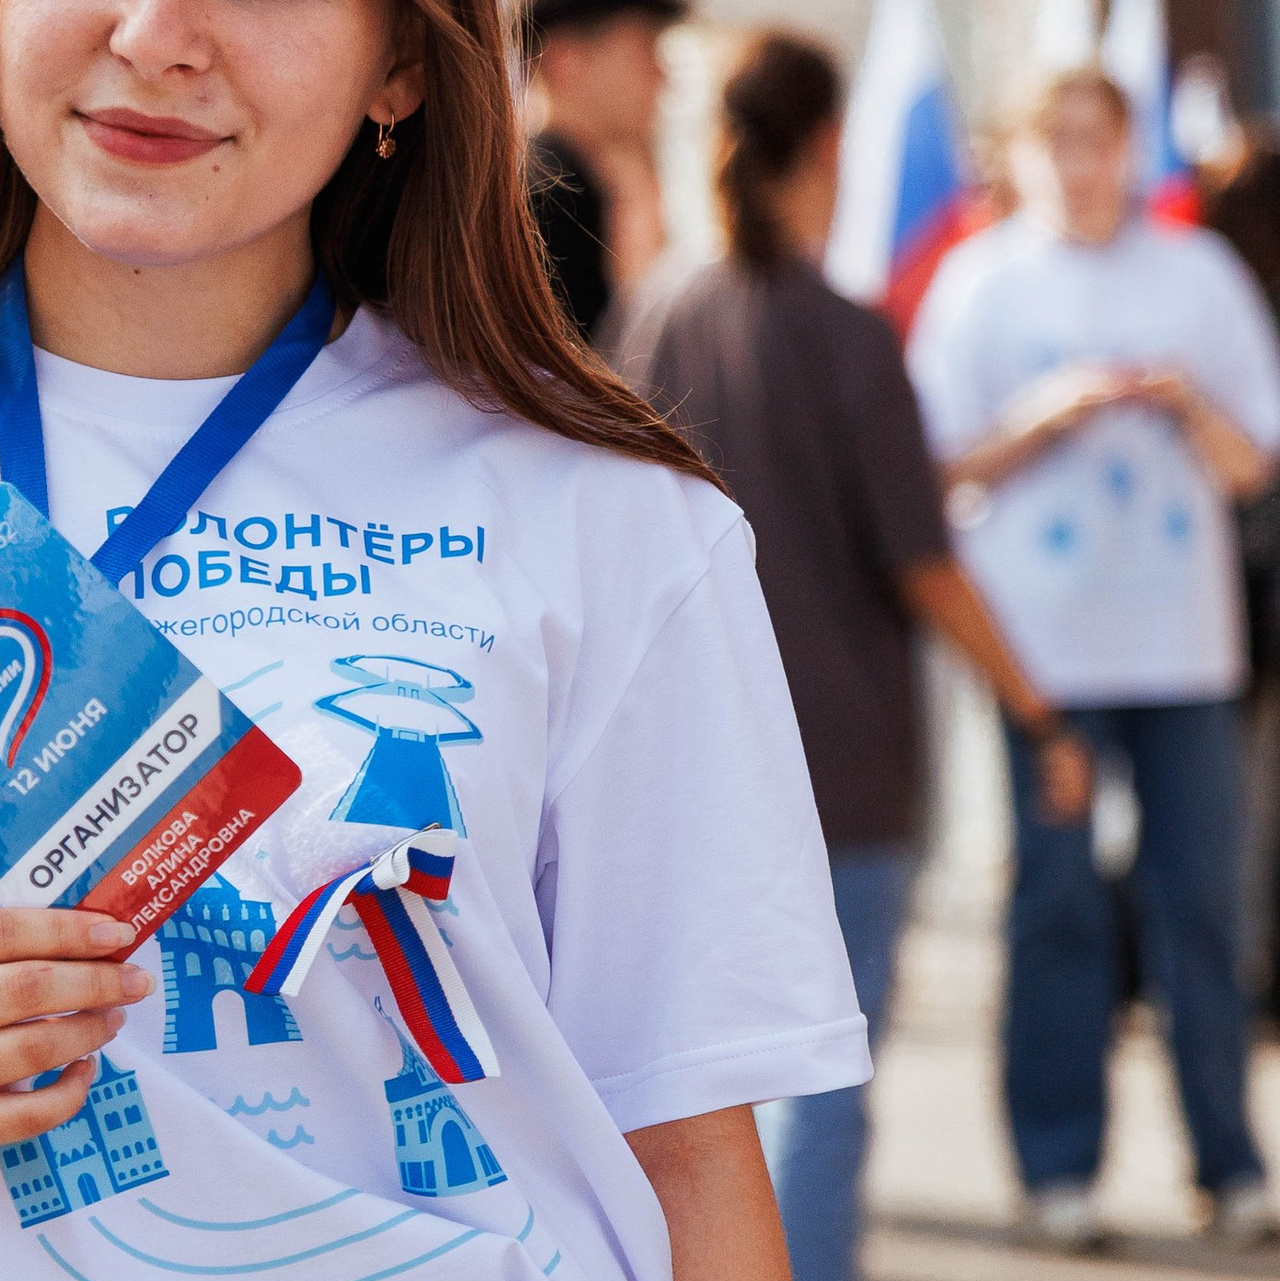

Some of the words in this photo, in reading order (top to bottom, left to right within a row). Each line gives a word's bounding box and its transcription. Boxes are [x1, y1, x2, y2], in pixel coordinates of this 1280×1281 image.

[153, 606, 361, 637] жегородской
[372, 613, 496, 654] области
[8, 768, 41, 796] 12
[33, 698, 108, 774] ИЮНЯ
[29, 713, 198, 889] ОРГАНИЗАТОР
[121, 810, 199, 886] ВОЛКОВА
[130, 808, 256, 934] ЛЕКСАНДРОВНА
[146, 834, 204, 890] АЛИНА
